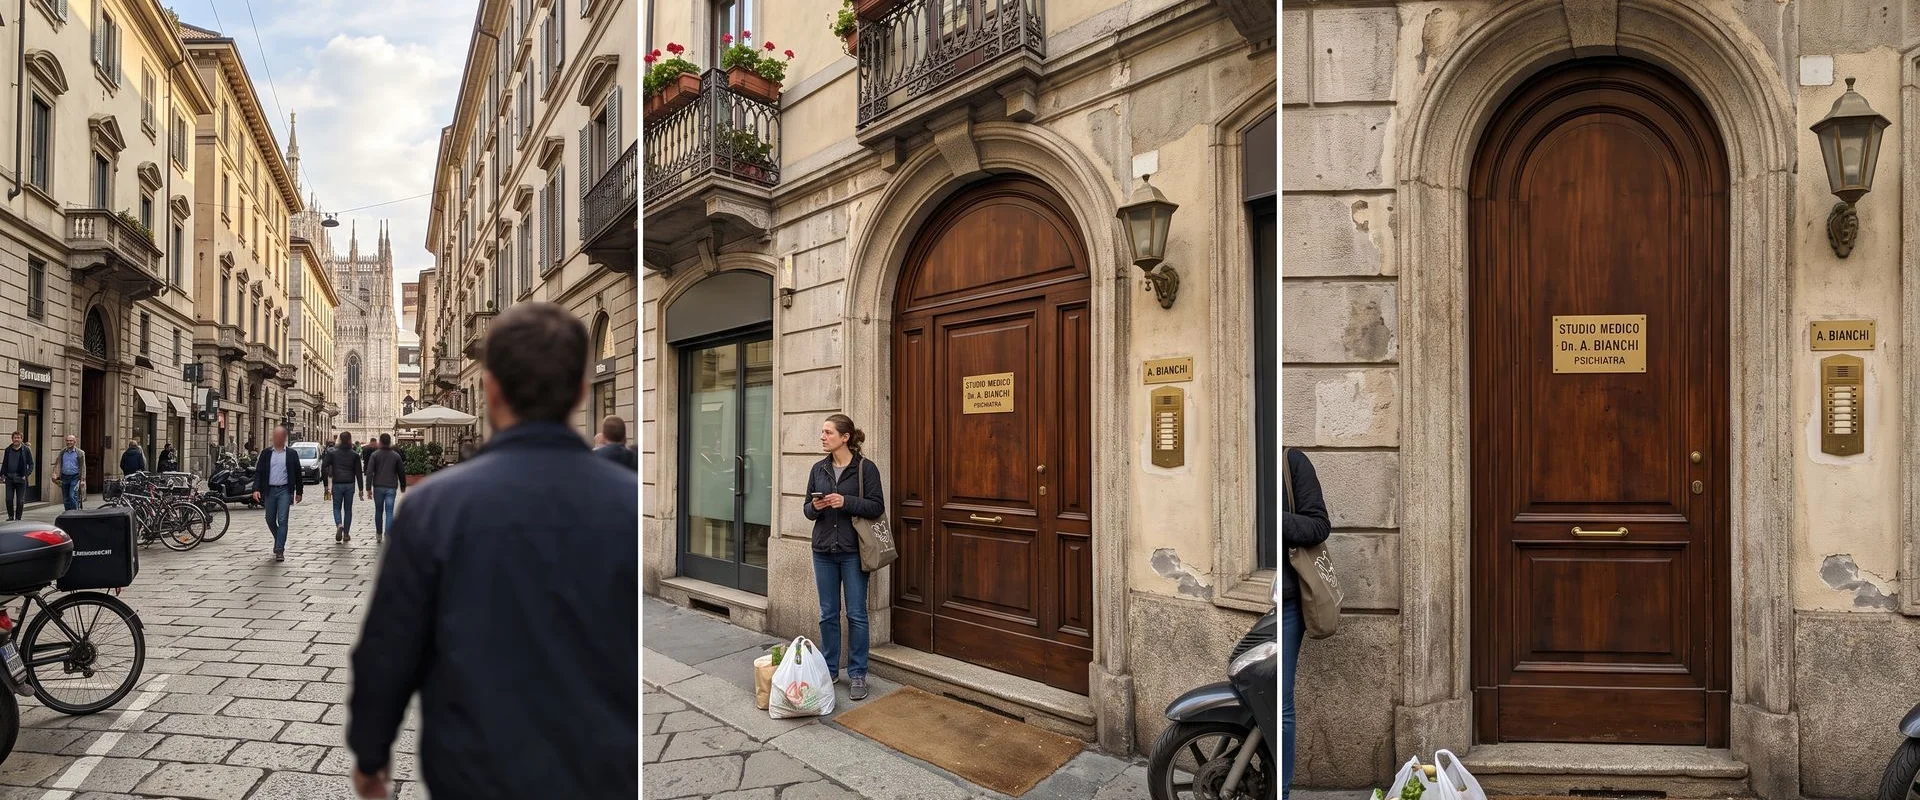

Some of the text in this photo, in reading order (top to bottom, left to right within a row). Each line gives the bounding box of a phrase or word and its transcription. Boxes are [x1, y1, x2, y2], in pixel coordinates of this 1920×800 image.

[1559, 323, 1640, 334] STUDIO MEDICO
[1816, 329, 1869, 341] A. BIANCHI
[1580, 340, 1590, 351] A.
[1594, 339, 1639, 351] BIANCHI
[1574, 356, 1626, 365] PSICHIATRA
[1147, 364, 1188, 376] A. BIANCHI
[965, 378, 1011, 389] STUDIO MEDICO
[984, 389, 1010, 399] BIANCHI
